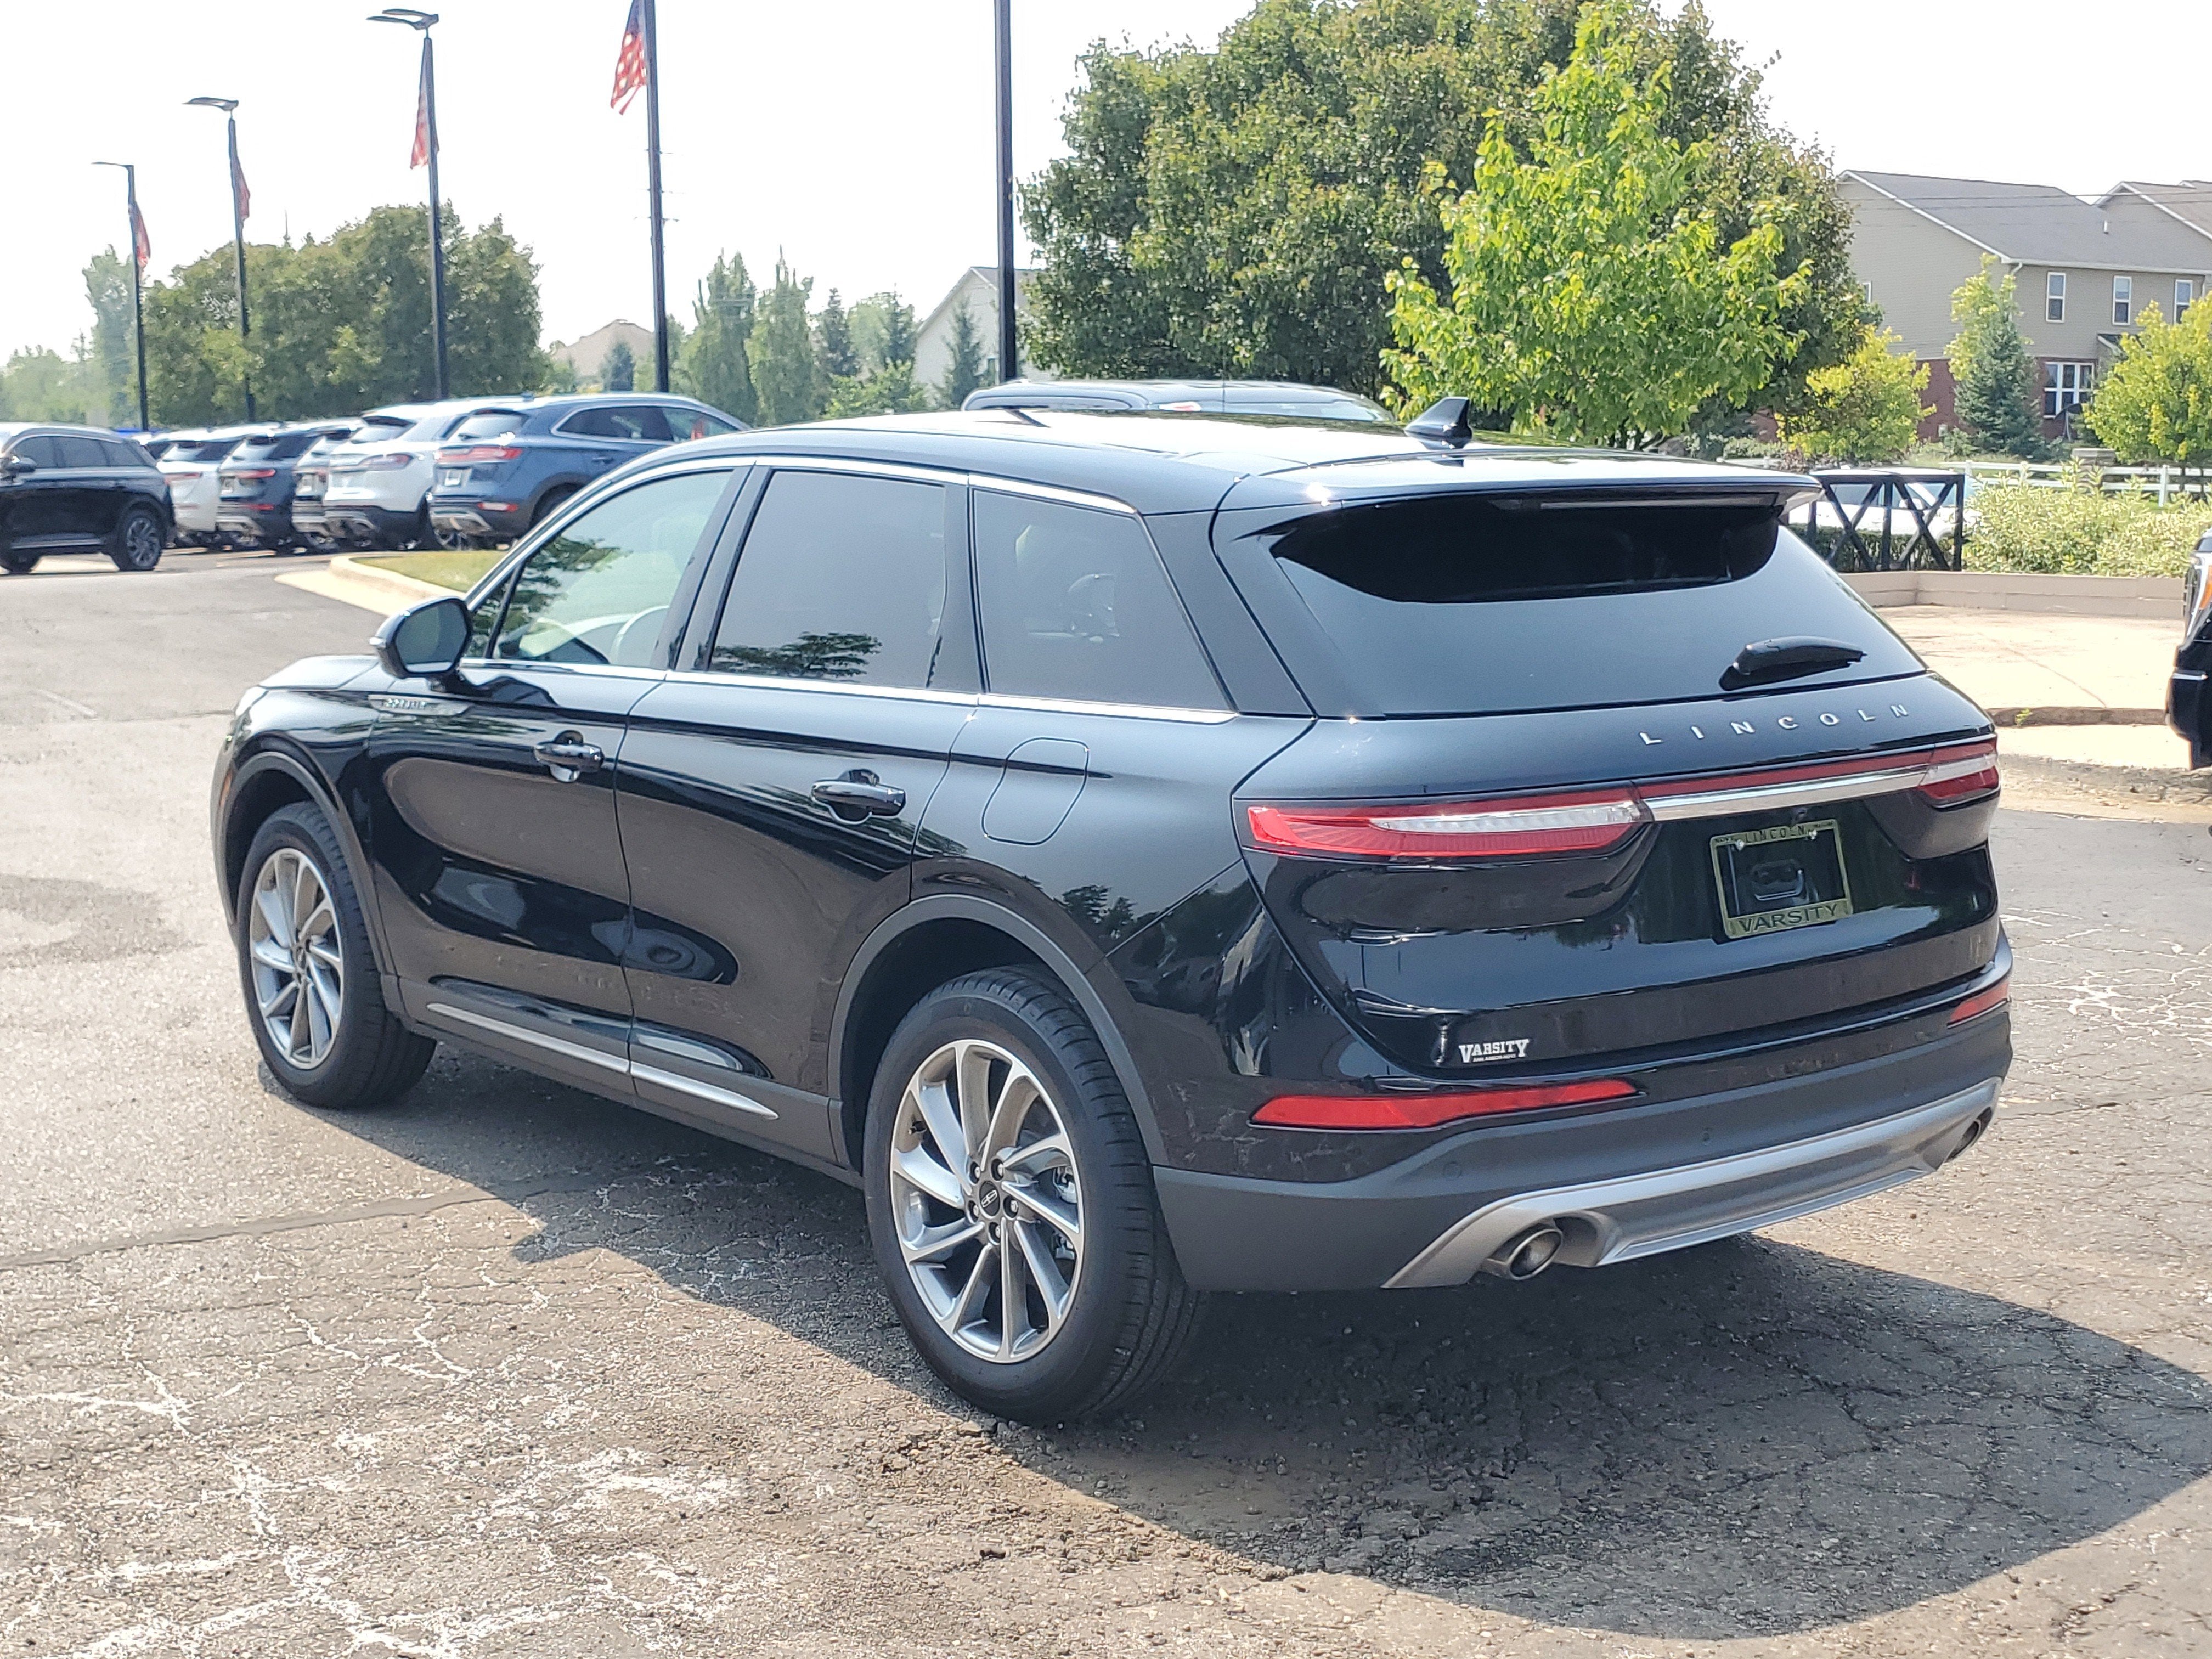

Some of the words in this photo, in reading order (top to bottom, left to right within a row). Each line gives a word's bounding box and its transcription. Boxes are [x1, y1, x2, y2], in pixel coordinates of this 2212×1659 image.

[1640, 704, 1909, 745] LINCOLN
[1739, 904, 1837, 932] VARSITY
[1458, 1039, 1530, 1063] VARSITY
